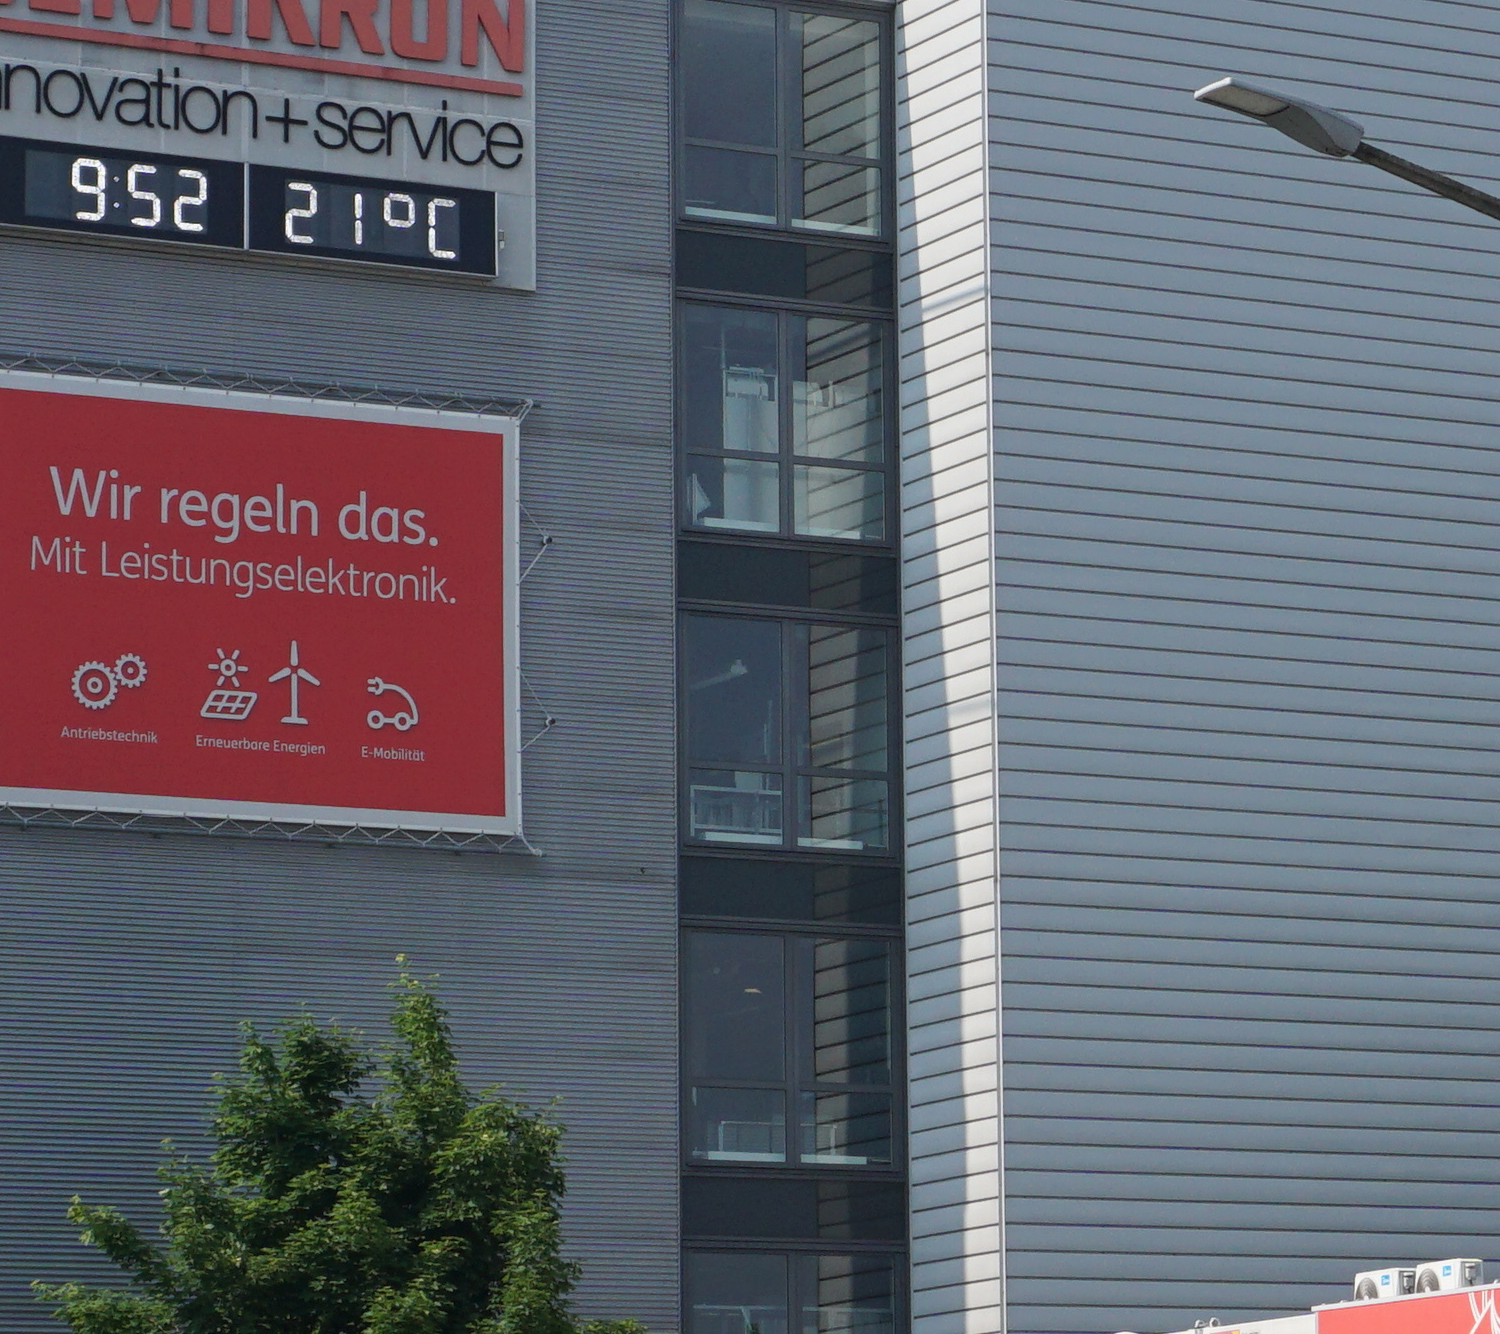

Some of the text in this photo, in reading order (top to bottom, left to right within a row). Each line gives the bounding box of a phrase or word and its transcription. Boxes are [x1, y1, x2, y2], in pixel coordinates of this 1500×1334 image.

[71, 157, 208, 232] 9:52
[49, 465, 440, 547] Wir regeln das.
[30, 534, 458, 605] Mit Leistungselektronik.
[60, 725, 158, 744] Antriebstechnik
[195, 734, 326, 757] Erneuerbare Energien
[361, 745, 426, 762] E-Mobilität
